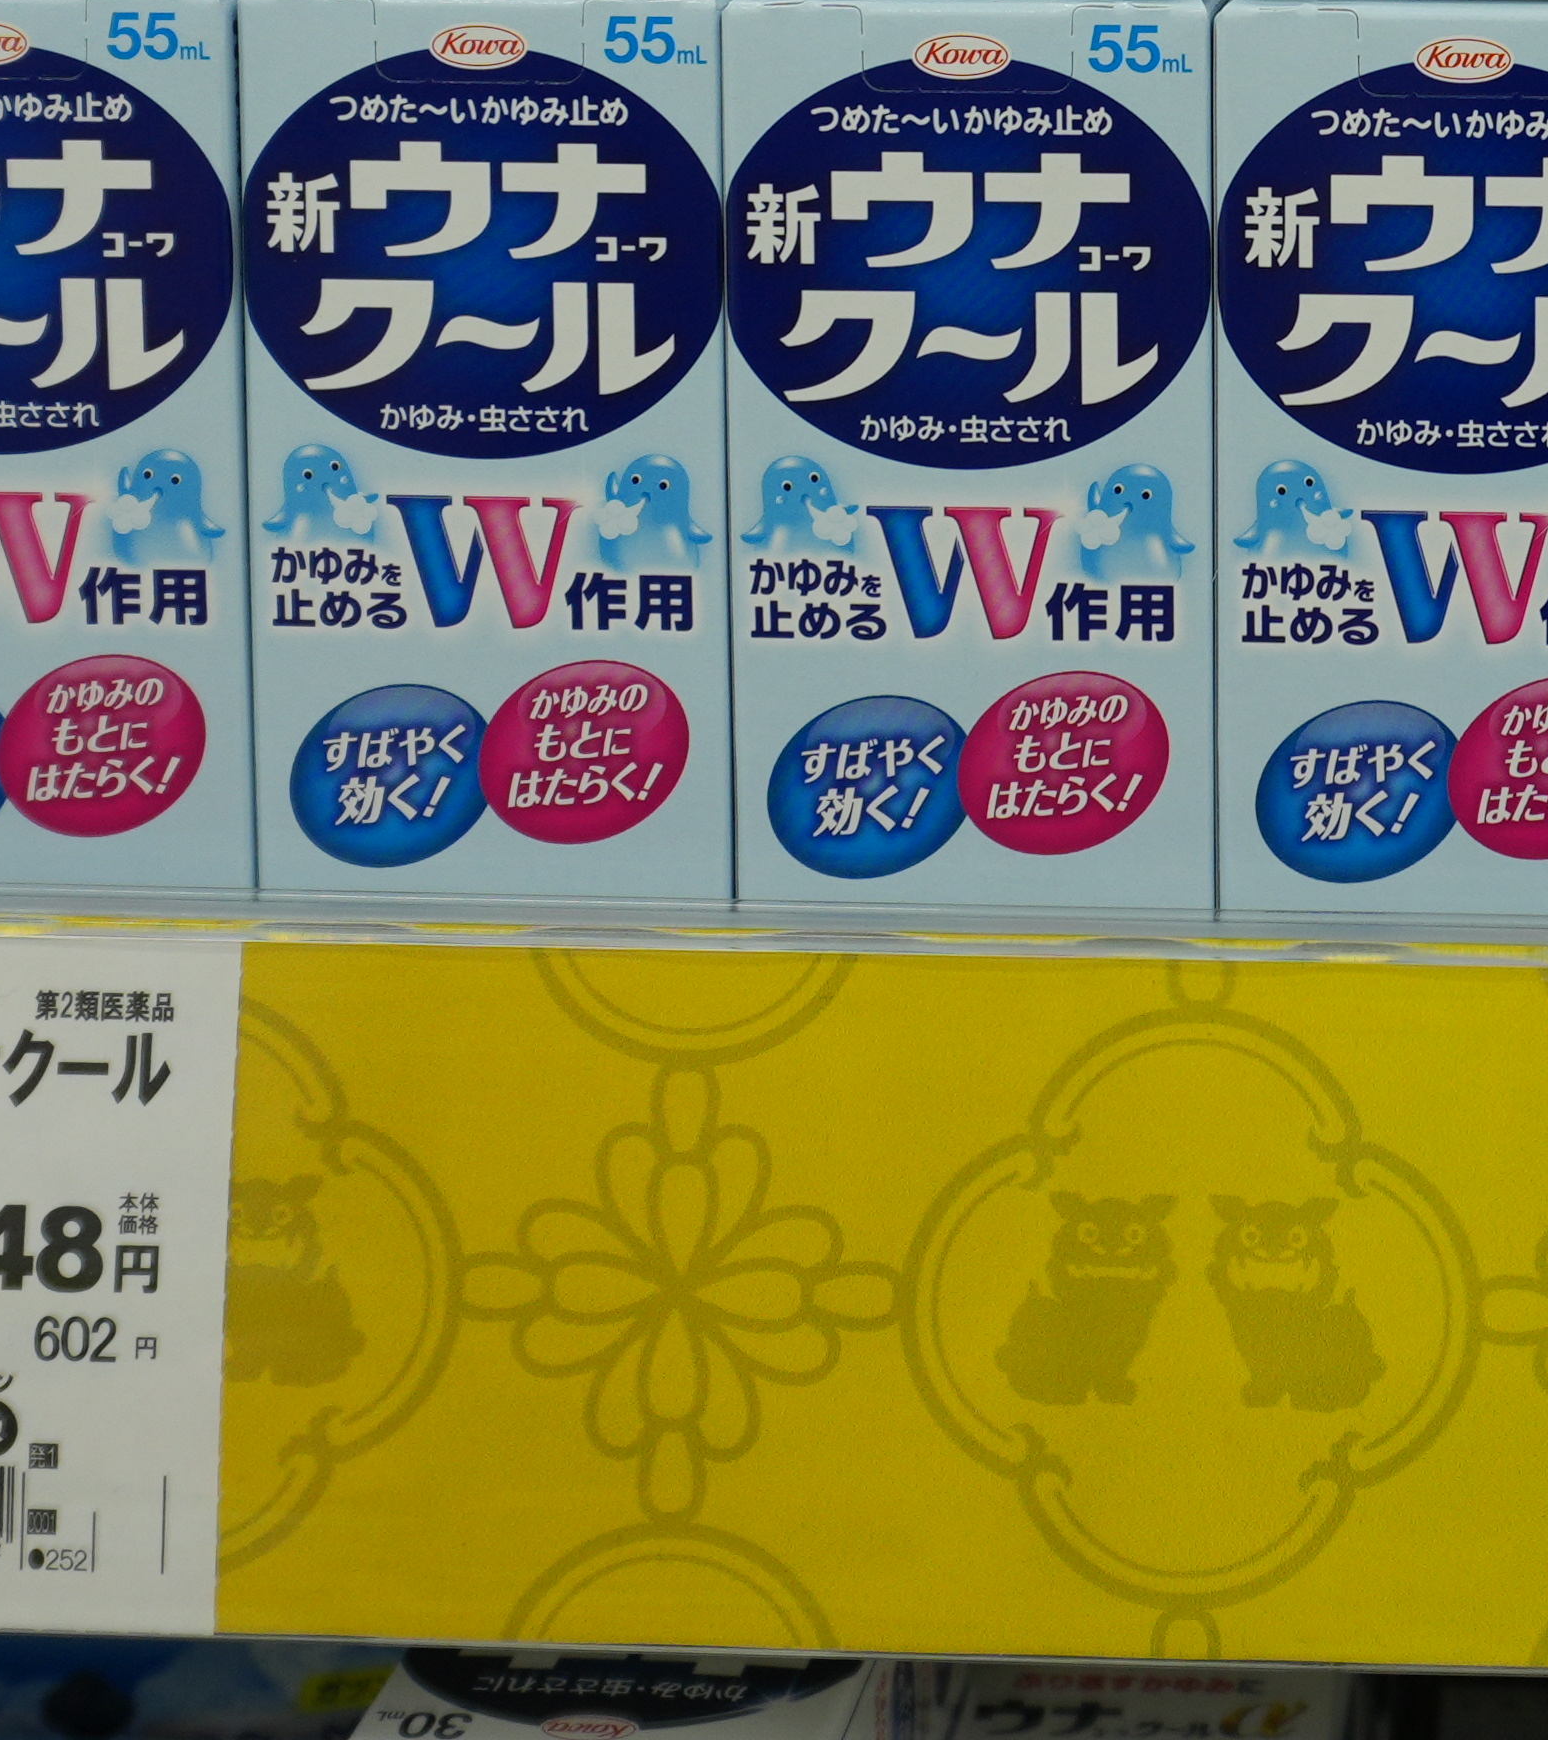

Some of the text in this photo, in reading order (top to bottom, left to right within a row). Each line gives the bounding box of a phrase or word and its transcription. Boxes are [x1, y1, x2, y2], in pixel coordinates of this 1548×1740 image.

[435, 29, 523, 57] Kowa
[603, 17, 707, 64] 55mL
[1421, 42, 1510, 71] Kowa
[529, 683, 648, 721] かゆみの
[323, 723, 469, 773] すばやく
[533, 721, 632, 761] もとに
[1290, 739, 1438, 790] すばやく
[35, 990, 175, 1022] 第2類医薬品
[118, 1193, 159, 1212] 本体
[118, 1215, 158, 1235] 価格
[114, 1245, 159, 1293] 円
[34, 1316, 157, 1363] 602 円
